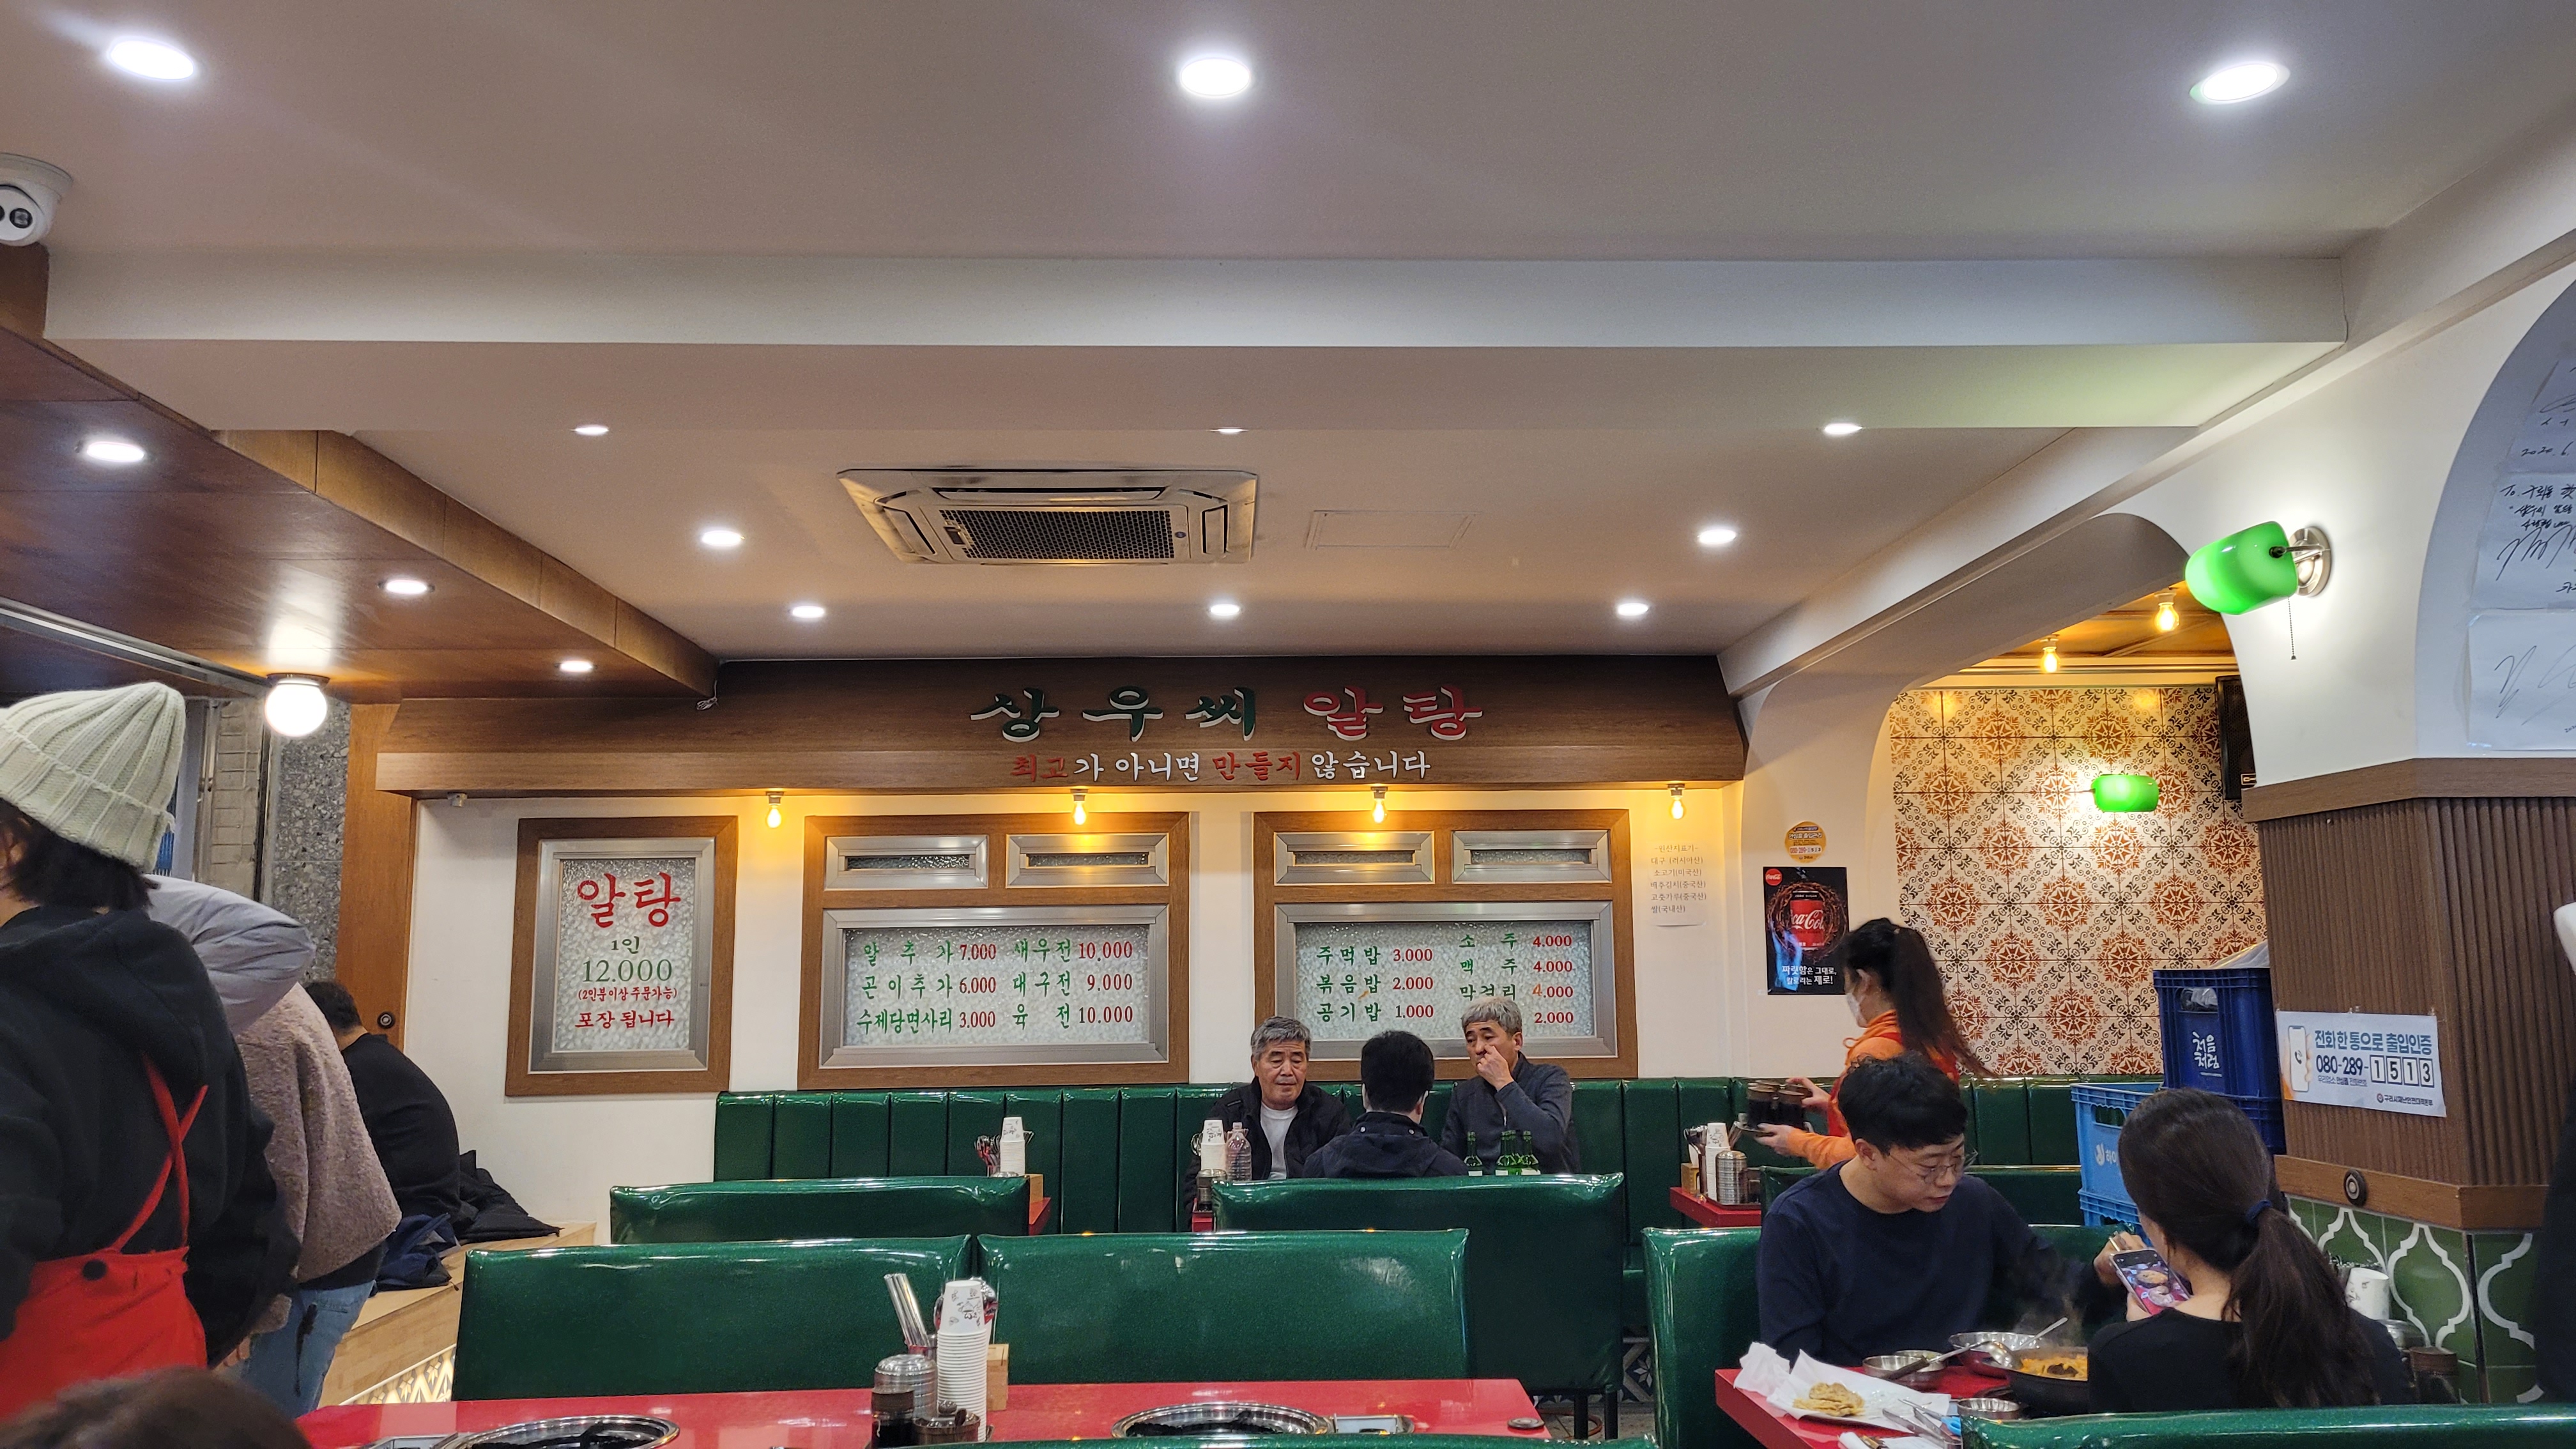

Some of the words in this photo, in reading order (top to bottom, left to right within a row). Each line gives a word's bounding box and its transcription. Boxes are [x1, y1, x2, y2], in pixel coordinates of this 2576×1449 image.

[970, 686, 1255, 742] 상우씨
[1304, 686, 1482, 741] 알탕
[1011, 753, 1105, 783] 최고가
[1116, 752, 1199, 782] 아니면
[1213, 751, 1301, 781] 만들지
[1311, 750, 1431, 779] 않습니다
[1651, 857, 1666, 865] 대구
[578, 871, 681, 928] 알탕
[611, 936, 640, 954] 1인
[1533, 935, 1572, 947] 4.000
[960, 943, 997, 961] 7.000
[1078, 941, 1133, 962] 10.000
[1393, 948, 1433, 962] 3.000
[583, 959, 673, 983] 12.000
[1533, 960, 1573, 972] 4.000
[1815, 967, 1837, 976] 그대로,
[960, 976, 997, 994] 6.000
[1087, 973, 1133, 992] 9.000
[1392, 976, 1434, 990] 2.000
[1814, 976, 1834, 985] 제로!
[1531, 983, 1574, 998] 4.000
[575, 1011, 616, 1029] 포장
[620, 1009, 675, 1029] 됩니다
[960, 1011, 996, 1028] 3.000
[1079, 1006, 1133, 1023] 10.000
[1395, 1004, 1434, 1018] 1.000
[1534, 1011, 1574, 1024] 2.000
[2192, 1031, 2216, 1053] 처음
[2315, 1030, 2336, 1049] 전화
[2337, 1031, 2348, 1050] 한
[2350, 1032, 2384, 1052] 통으로
[2386, 1033, 2432, 1055] 출입인증
[2194, 1052, 2220, 1070] 처럼
